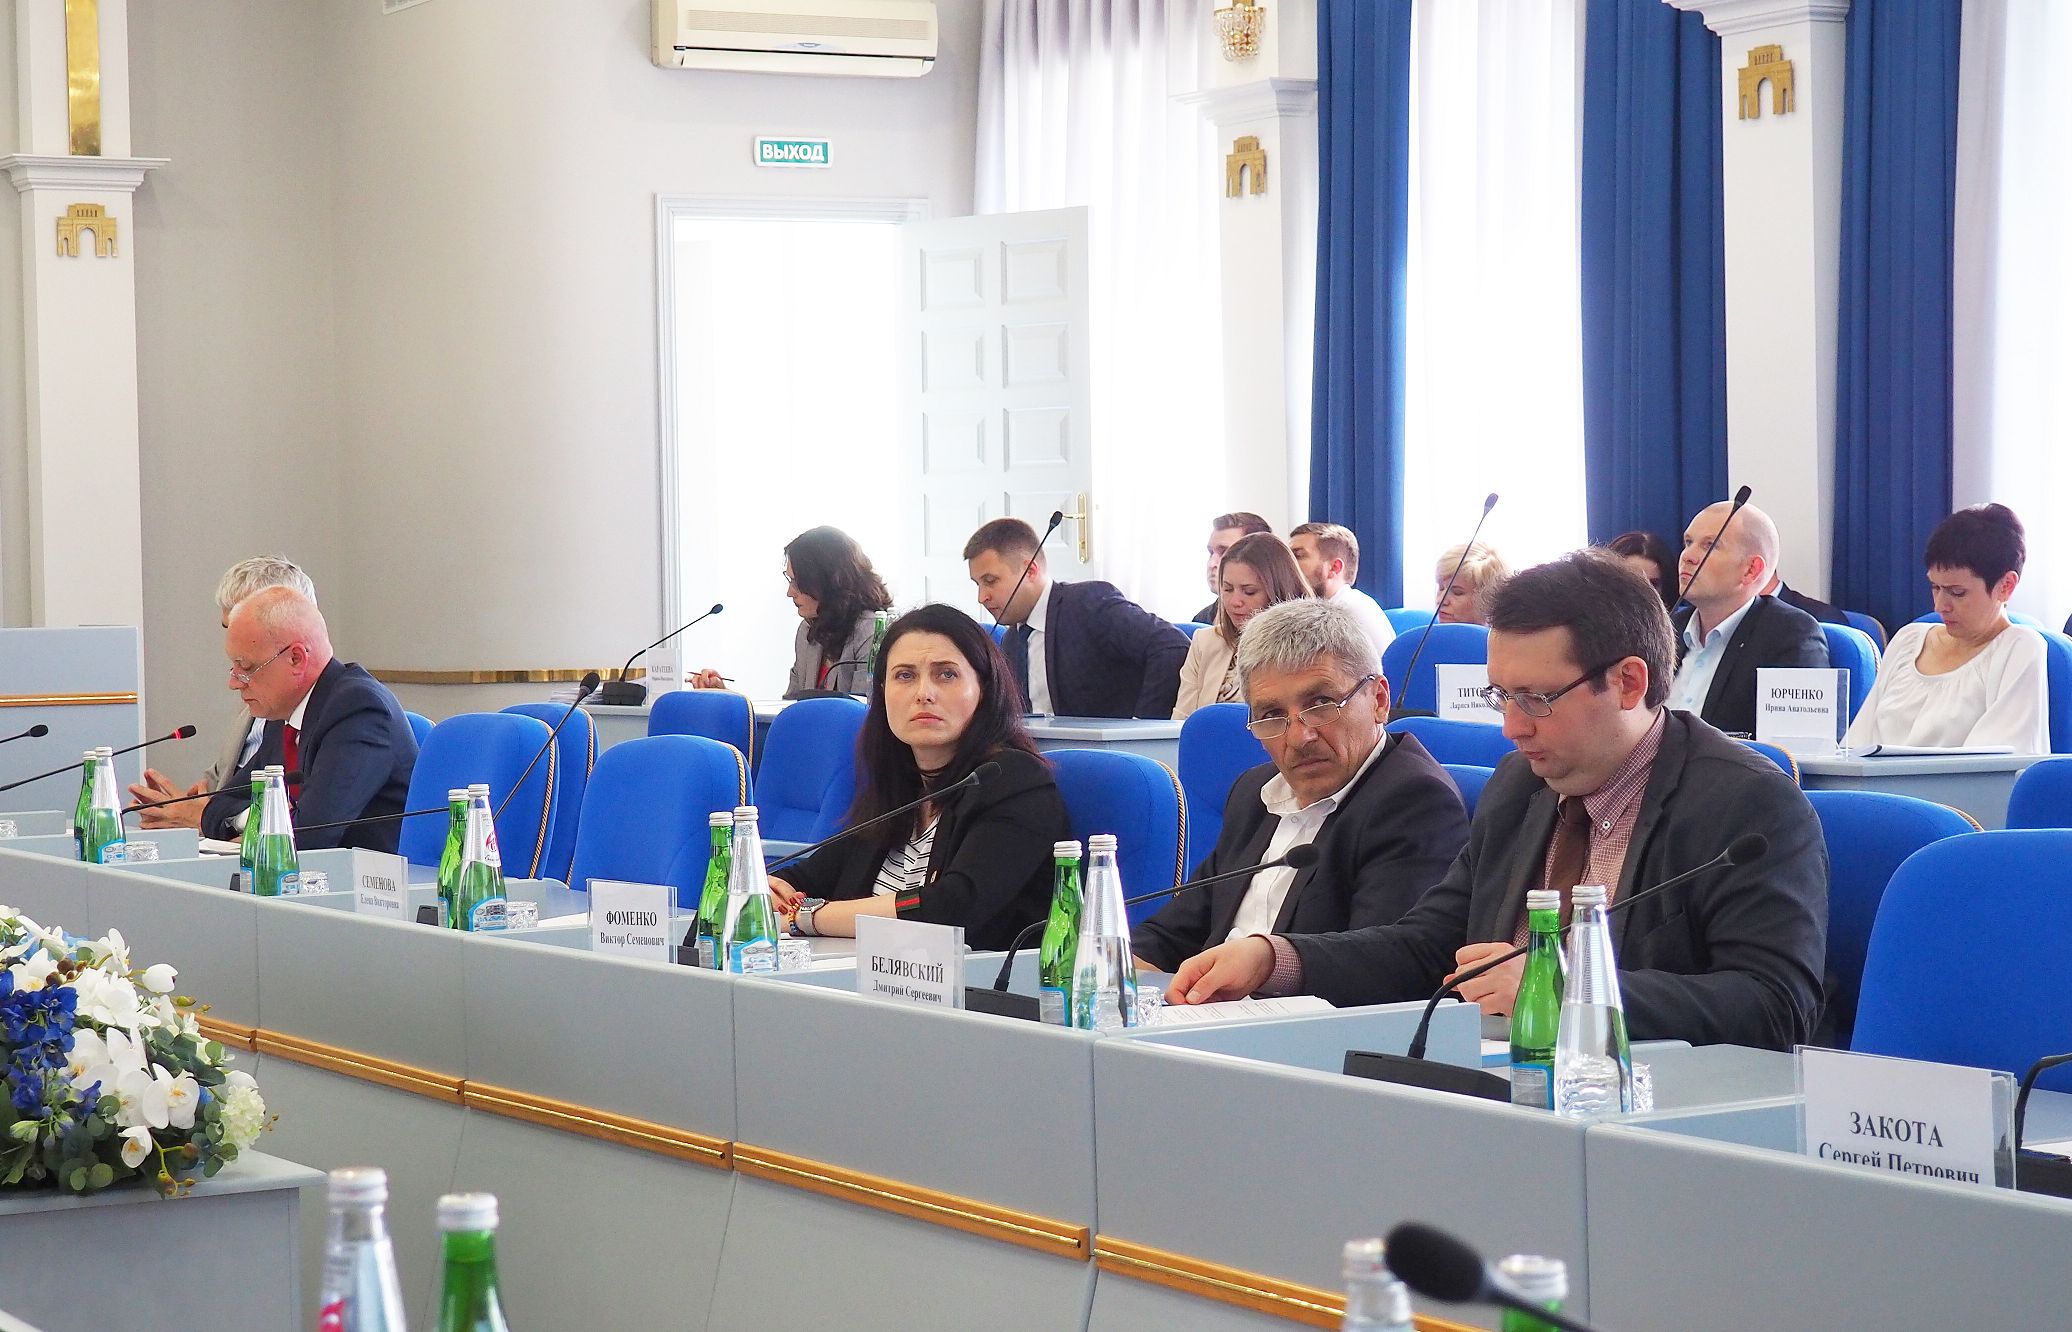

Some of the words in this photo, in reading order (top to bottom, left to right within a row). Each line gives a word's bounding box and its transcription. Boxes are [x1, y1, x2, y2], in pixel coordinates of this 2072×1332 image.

[762, 143, 825, 161] ВЫХОД
[1771, 688, 1824, 701] ЮРЧЕНКО
[1765, 703, 1786, 713] Ирина
[1788, 705, 1829, 714] Анатольевна
[362, 874, 396, 892] СЕМЕНОВА
[606, 910, 657, 927] ФОМЕНКО
[600, 931, 625, 948] Виктор
[626, 932, 665, 946] Семенович
[871, 955, 944, 984] БЕЛЯВСКИЙ
[873, 979, 904, 997] Дмитрий
[905, 985, 942, 1003] Сергеевич
[1850, 1111, 1944, 1148] ЗАКОТА
